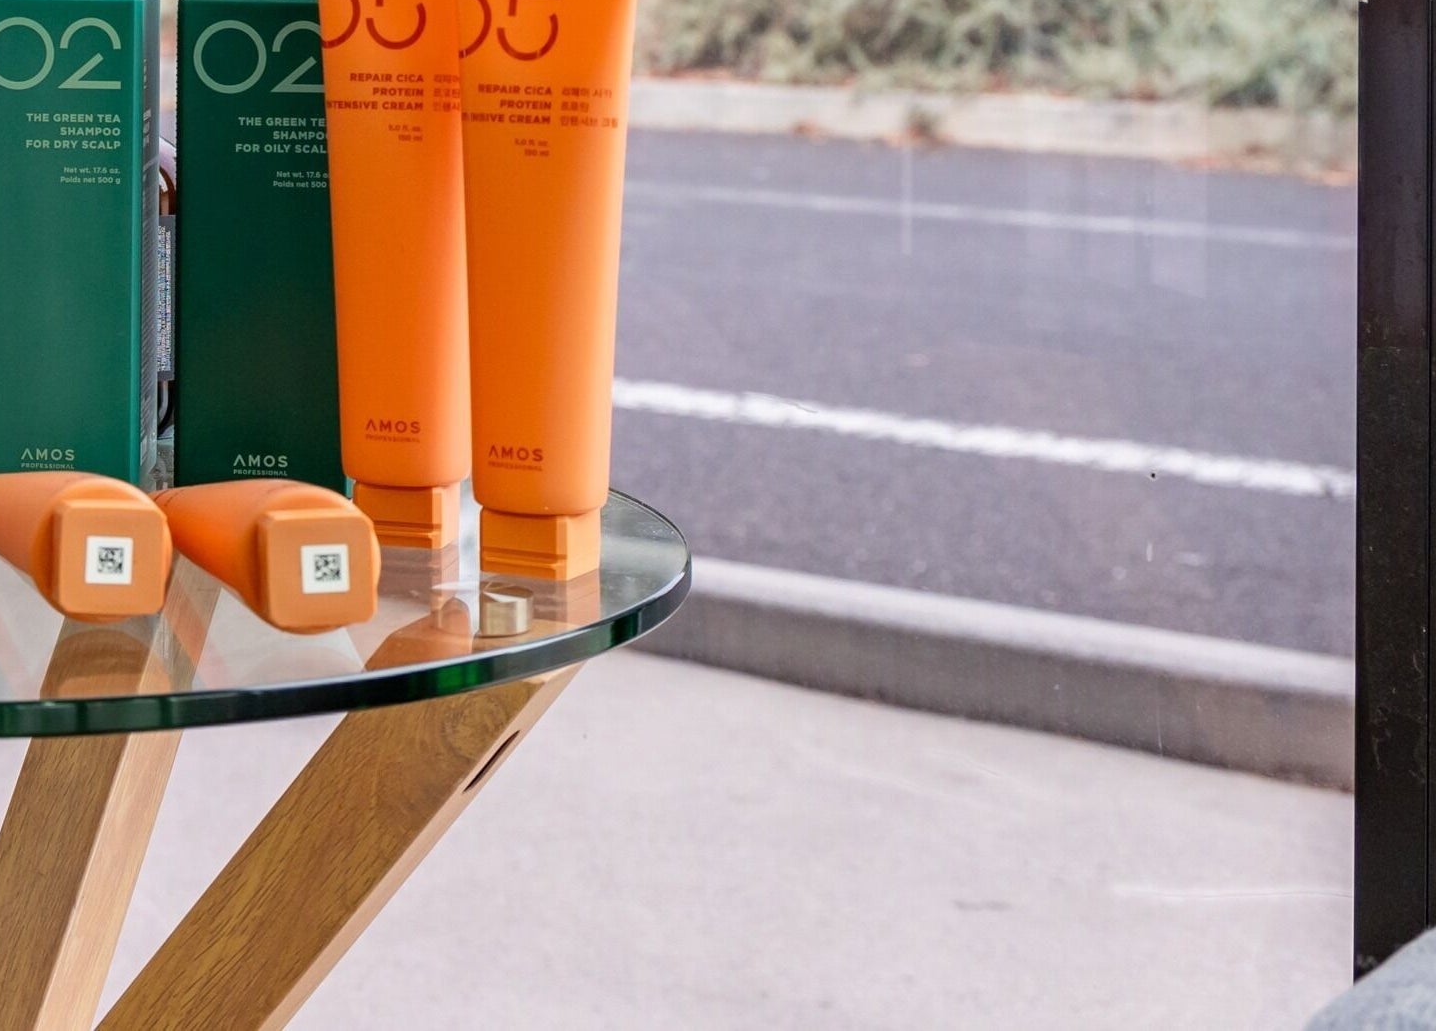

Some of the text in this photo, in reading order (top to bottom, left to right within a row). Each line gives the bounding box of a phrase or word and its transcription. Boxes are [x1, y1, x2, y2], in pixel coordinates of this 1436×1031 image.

[193, 20, 325, 94] 02
[349, 73, 393, 82] REPAIR
[396, 74, 424, 83] CICA
[372, 87, 424, 97] PROTEIN
[478, 83, 553, 96] REPAIR CICA
[382, 101, 424, 110] CREAM
[499, 100, 552, 110] PROTEIN
[26, 113, 121, 123] THE GREEN TEA
[238, 117, 326, 127] THE GREEN TE
[508, 114, 551, 124] CREAM
[60, 127, 121, 136] SHAMPOO
[273, 131, 328, 140] SHAMPO
[26, 139, 121, 149] FOR DRY SCALP
[235, 143, 327, 154] FOR OILY SCAL
[273, 180, 295, 188] Poids
[365, 418, 421, 434] AMOS
[20, 448, 76, 461] AMOS
[488, 444, 543, 462] AMOS
[20, 462, 75, 470] PROFESSIONAL
[233, 454, 288, 468] AMOS
[233, 469, 288, 477] PROFESSIONAL
